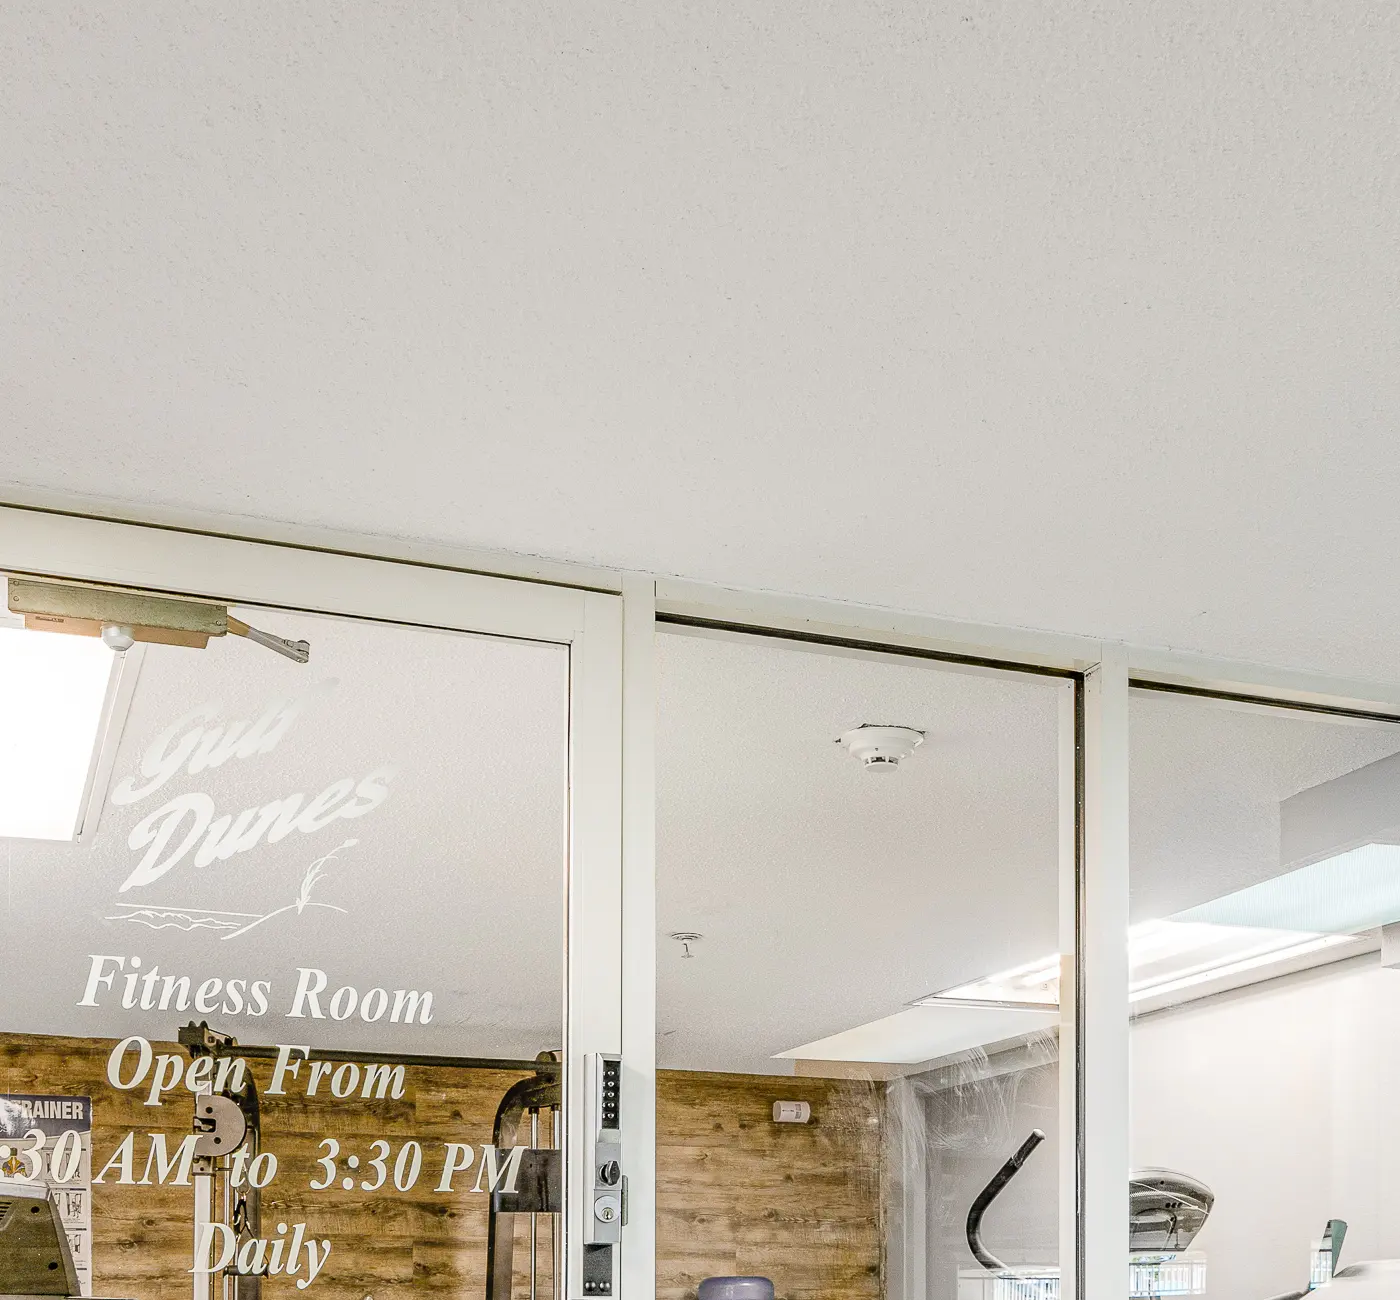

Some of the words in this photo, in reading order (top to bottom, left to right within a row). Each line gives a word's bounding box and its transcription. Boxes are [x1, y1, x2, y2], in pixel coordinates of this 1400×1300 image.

[118, 764, 399, 893] Dunes
[76, 954, 272, 1017] Fitness
[285, 967, 435, 1025] Room
[106, 1035, 247, 1106] Open
[264, 1044, 406, 1099] From
[91, 1132, 203, 1185] AM
[229, 1142, 279, 1189] to
[310, 1138, 422, 1193] 3:30
[433, 1142, 529, 1194] PM
[187, 1221, 332, 1290] Daily
